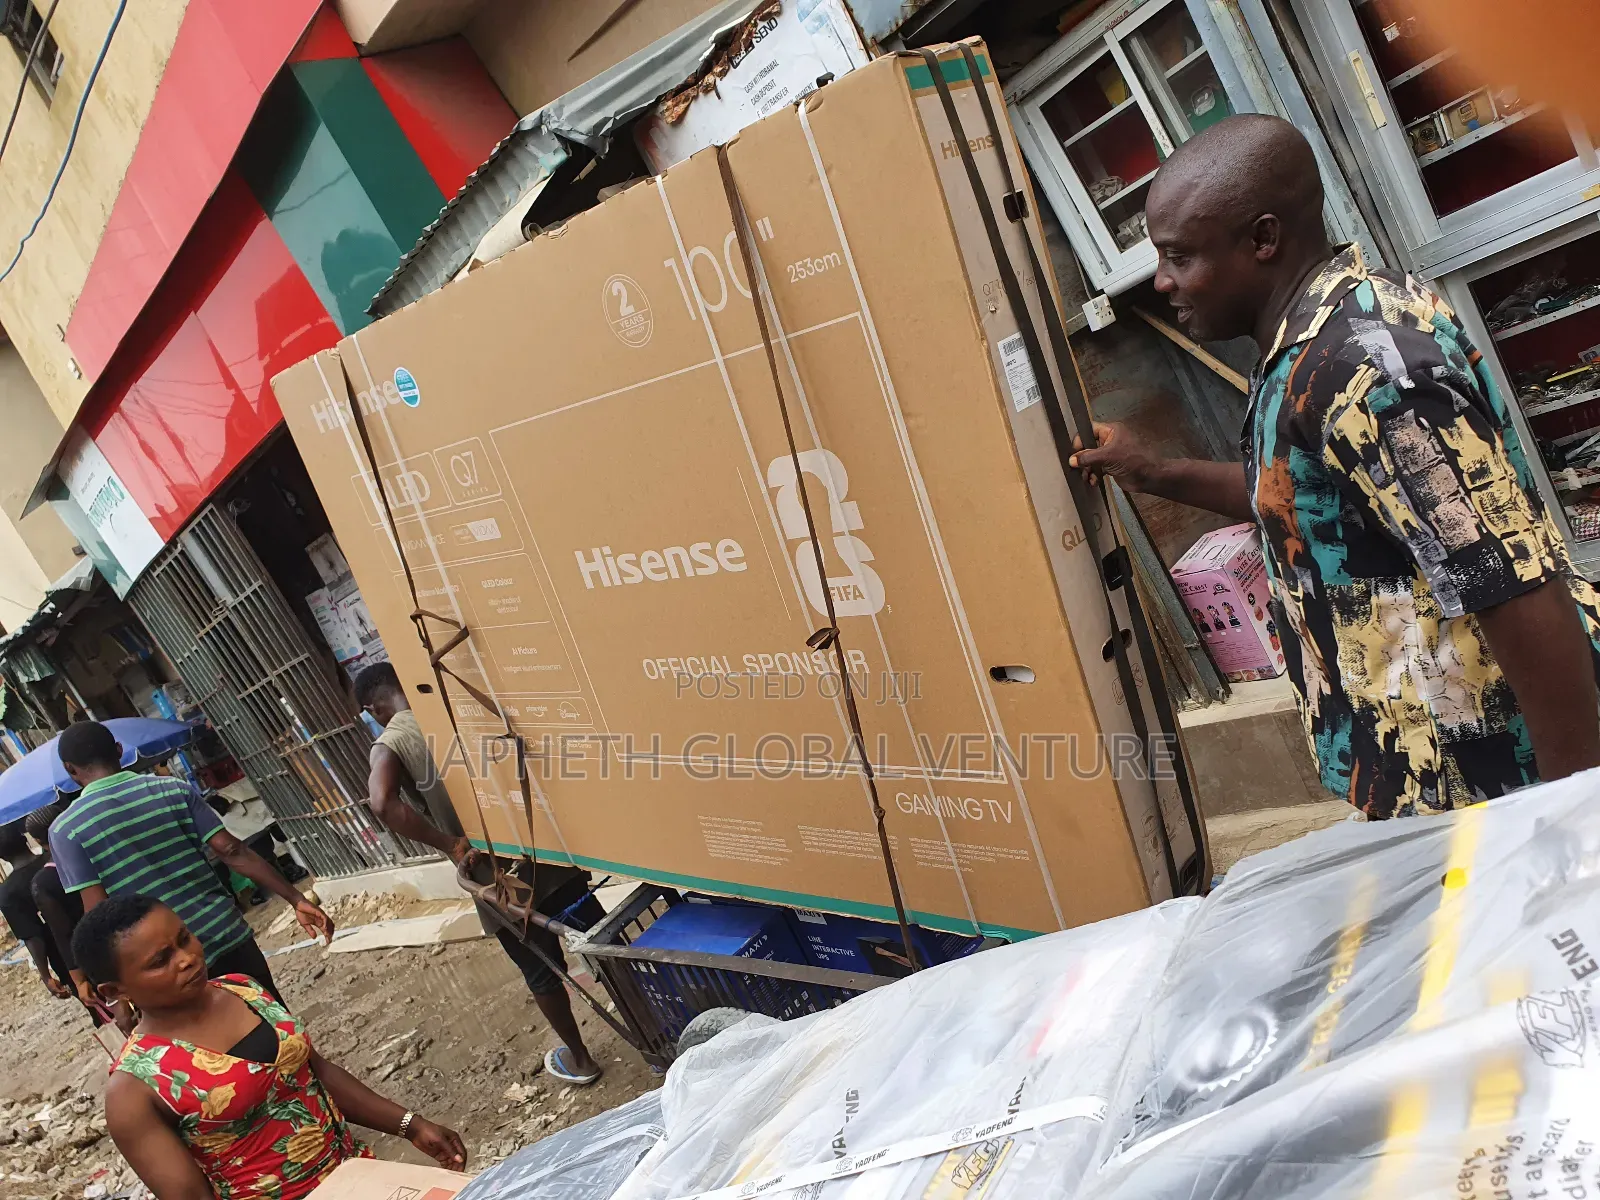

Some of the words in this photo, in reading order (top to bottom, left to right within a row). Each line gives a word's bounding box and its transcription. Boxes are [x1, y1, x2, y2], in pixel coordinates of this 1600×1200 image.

[753, 16, 779, 44] SEND
[760, 78, 777, 98] DEPOSIT
[786, 250, 842, 284] 253cm
[611, 281, 635, 317] 2
[618, 313, 645, 330] YEARS
[450, 450, 480, 488] Q7
[573, 537, 748, 590] Hisense
[827, 583, 866, 603] FIFA
[642, 653, 732, 681] OFFICIAL
[742, 649, 870, 679] SPONSOR
[455, 704, 486, 718] NETFLIX
[895, 791, 984, 821] GAMING
[983, 798, 1012, 824] TV
[807, 934, 824, 945] LINE
[811, 942, 857, 957] INTERACTIVE
[815, 952, 830, 962] UPS
